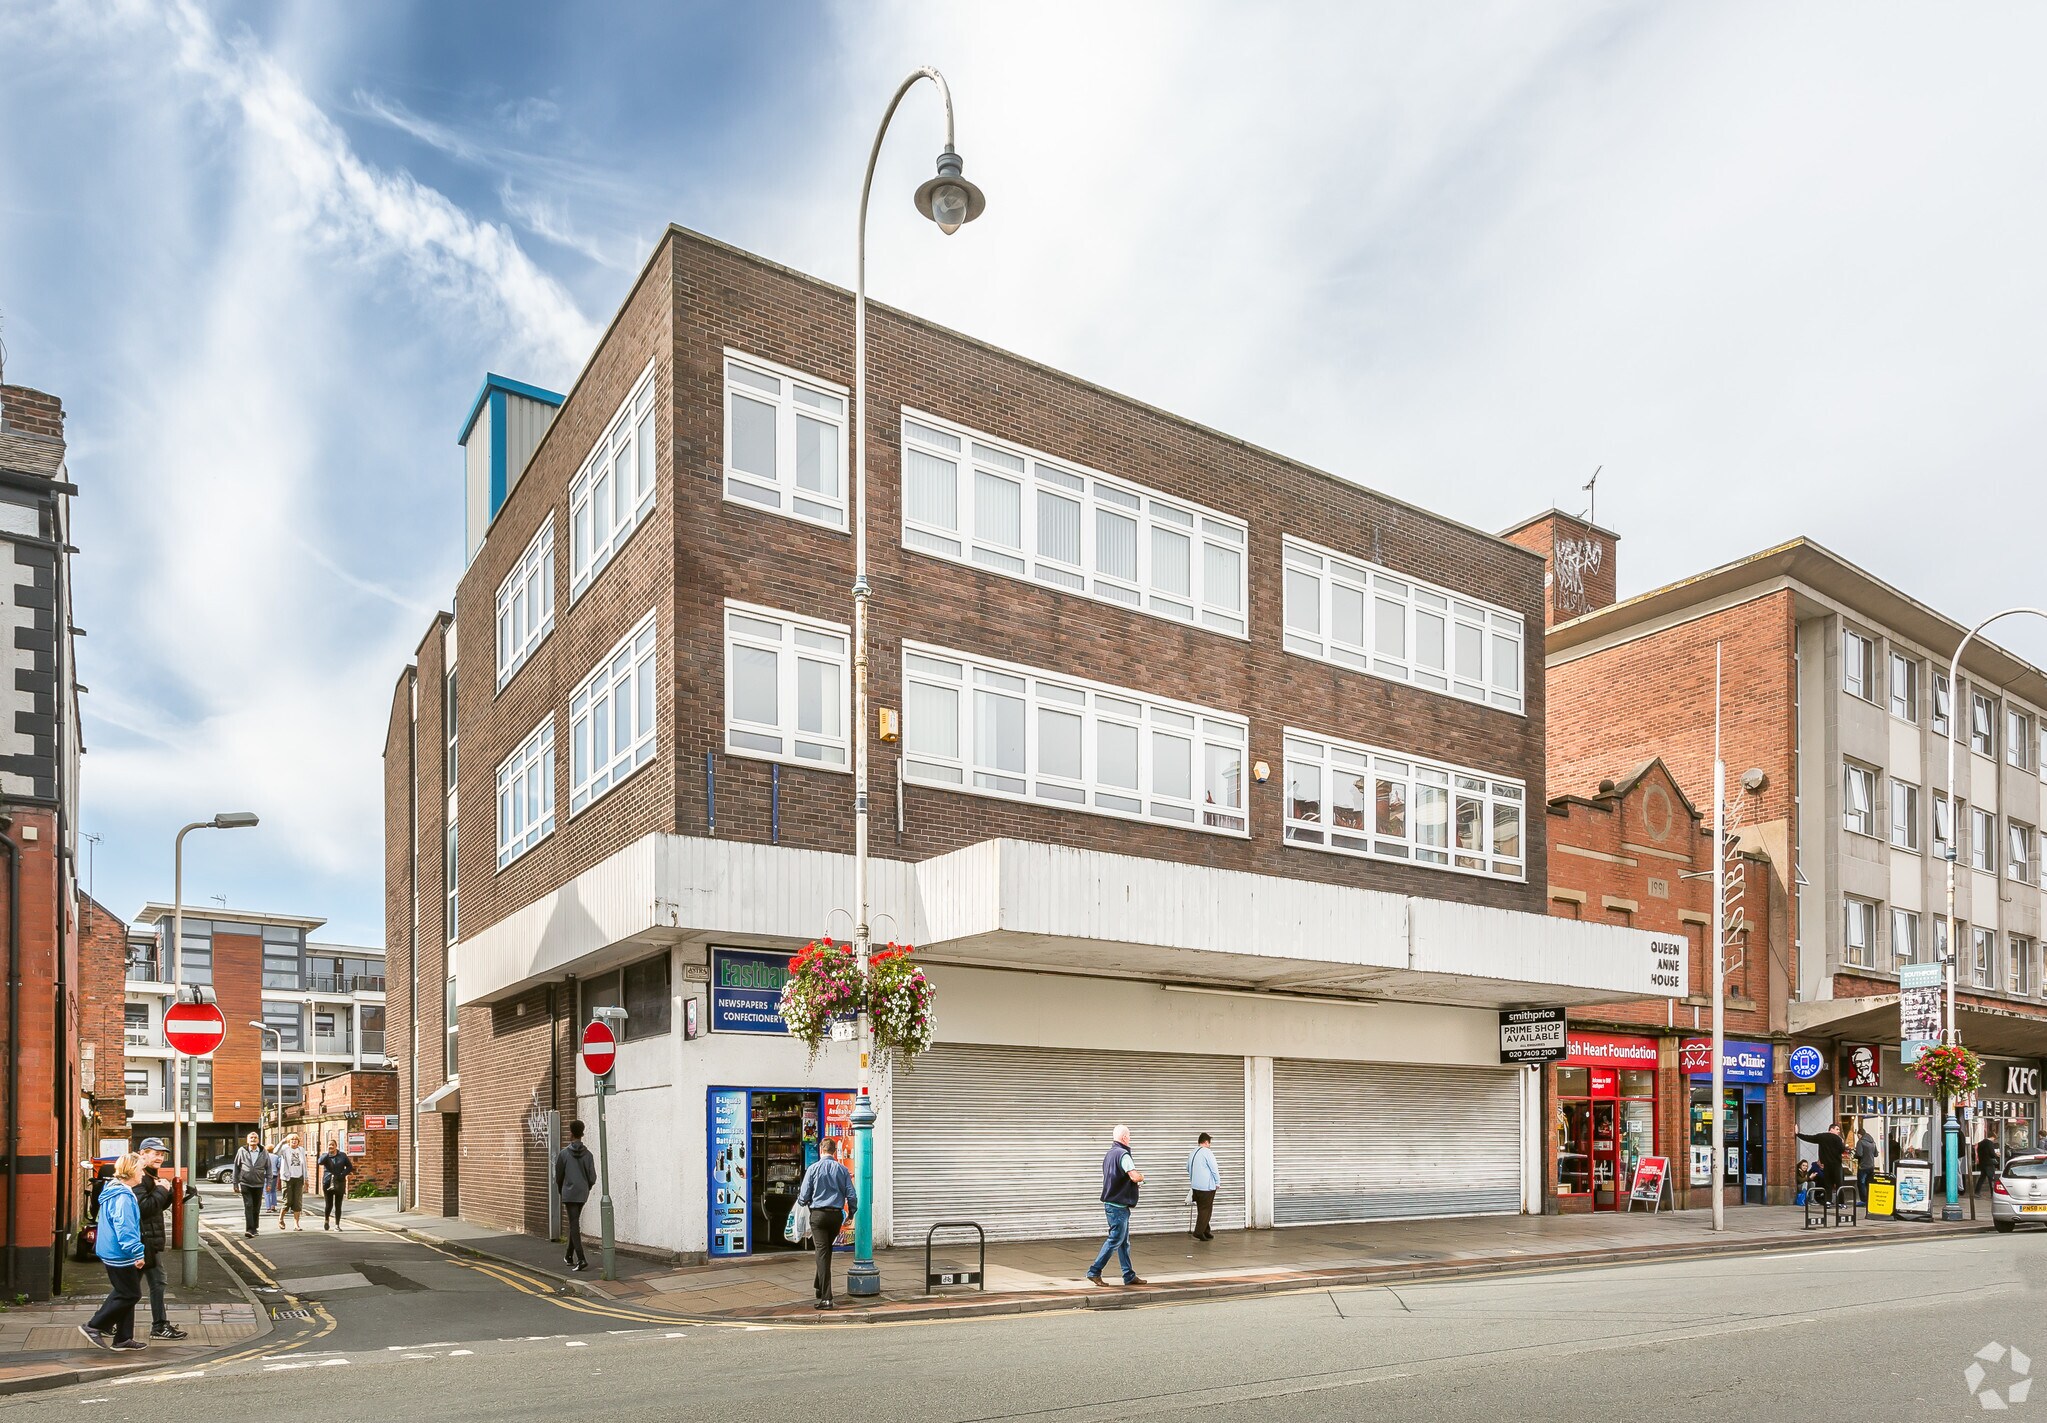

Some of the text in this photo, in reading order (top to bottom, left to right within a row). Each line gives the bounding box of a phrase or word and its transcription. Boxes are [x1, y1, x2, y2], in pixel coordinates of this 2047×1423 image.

[1651, 941, 1679, 955] QUEEN
[1657, 959, 1679, 971] ANNE
[1651, 974, 1679, 987] HOUSE
[718, 998, 768, 1010] NEWSPAPERS
[723, 1012, 783, 1024] CONFECTIONERY
[1509, 1010, 1555, 1021] smithprice
[1504, 1023, 1560, 1034] PRIME SHOP
[1507, 1032, 1559, 1042] AVAILABLE
[1567, 1041, 1656, 1059] ish Heart Foundation
[1793, 1049, 1817, 1060] PHONE
[1723, 1053, 1765, 1068] one Clinic
[1794, 1064, 1816, 1075] CLINIC
[2007, 1066, 2037, 1095] KFC
[716, 1096, 741, 1105] E-Liquids
[716, 1106, 733, 1115] E-Cigs
